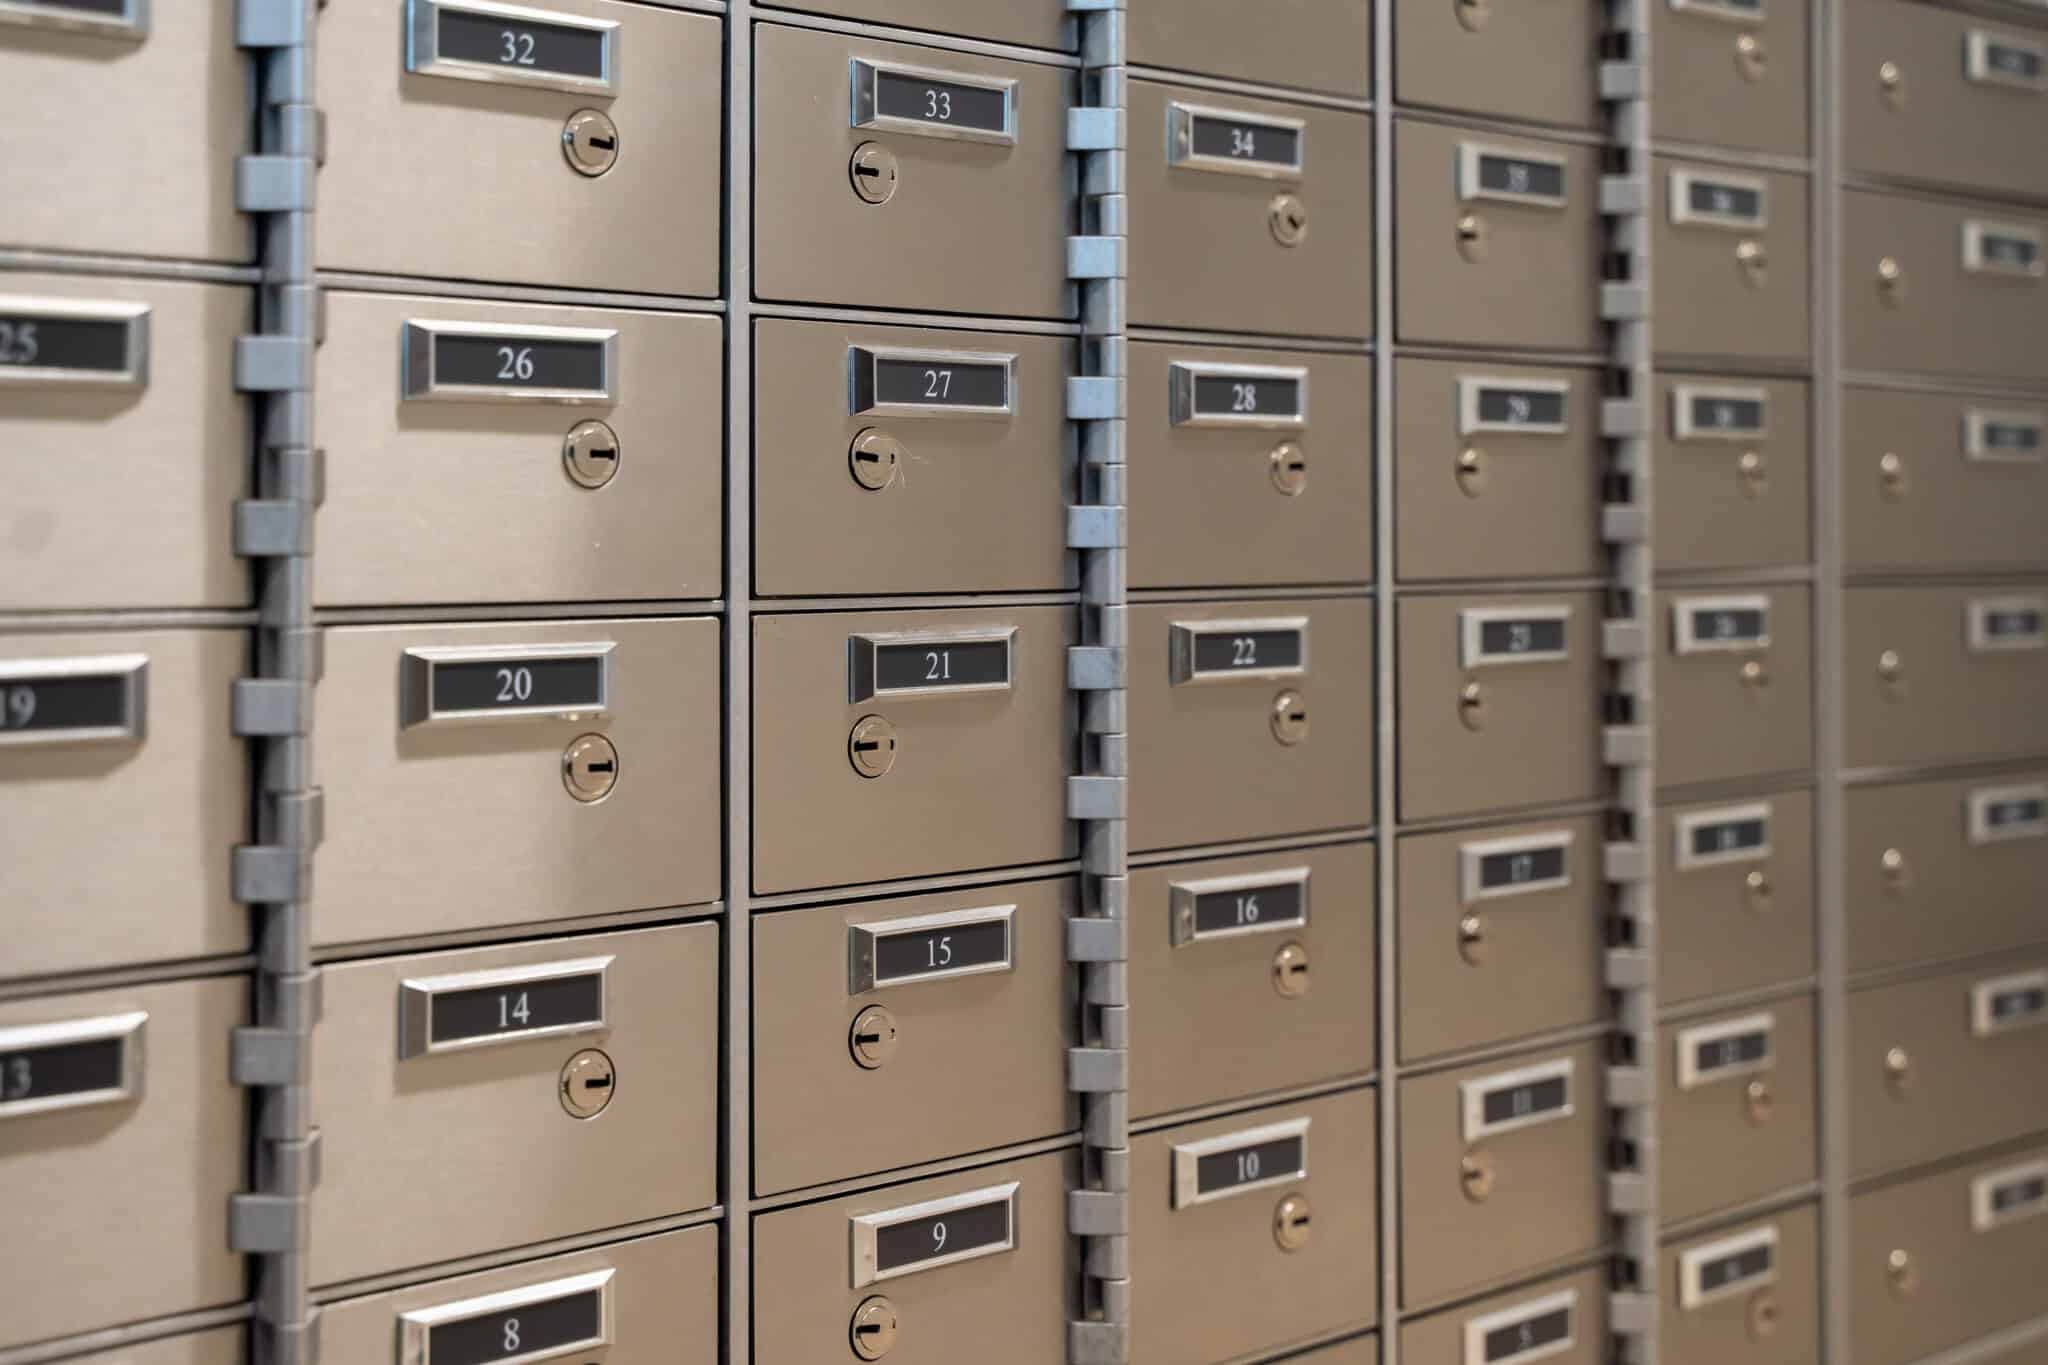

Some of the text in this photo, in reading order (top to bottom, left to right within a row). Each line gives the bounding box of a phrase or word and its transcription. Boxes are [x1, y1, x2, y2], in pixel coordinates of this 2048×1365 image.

[500, 31, 535, 65] 32
[925, 89, 951, 120] 33
[1231, 128, 1255, 157] 34
[497, 346, 534, 380] 26
[924, 370, 952, 399] 27
[1232, 384, 1256, 412] 28
[926, 652, 951, 680] 21
[1232, 638, 1256, 666] 22
[496, 667, 532, 702] 20
[1236, 895, 1259, 924] 16
[928, 936, 952, 968] 15
[498, 991, 531, 1028] 14
[1237, 1151, 1260, 1182] 10
[932, 1221, 947, 1253] 9
[503, 1318, 521, 1352] 8
